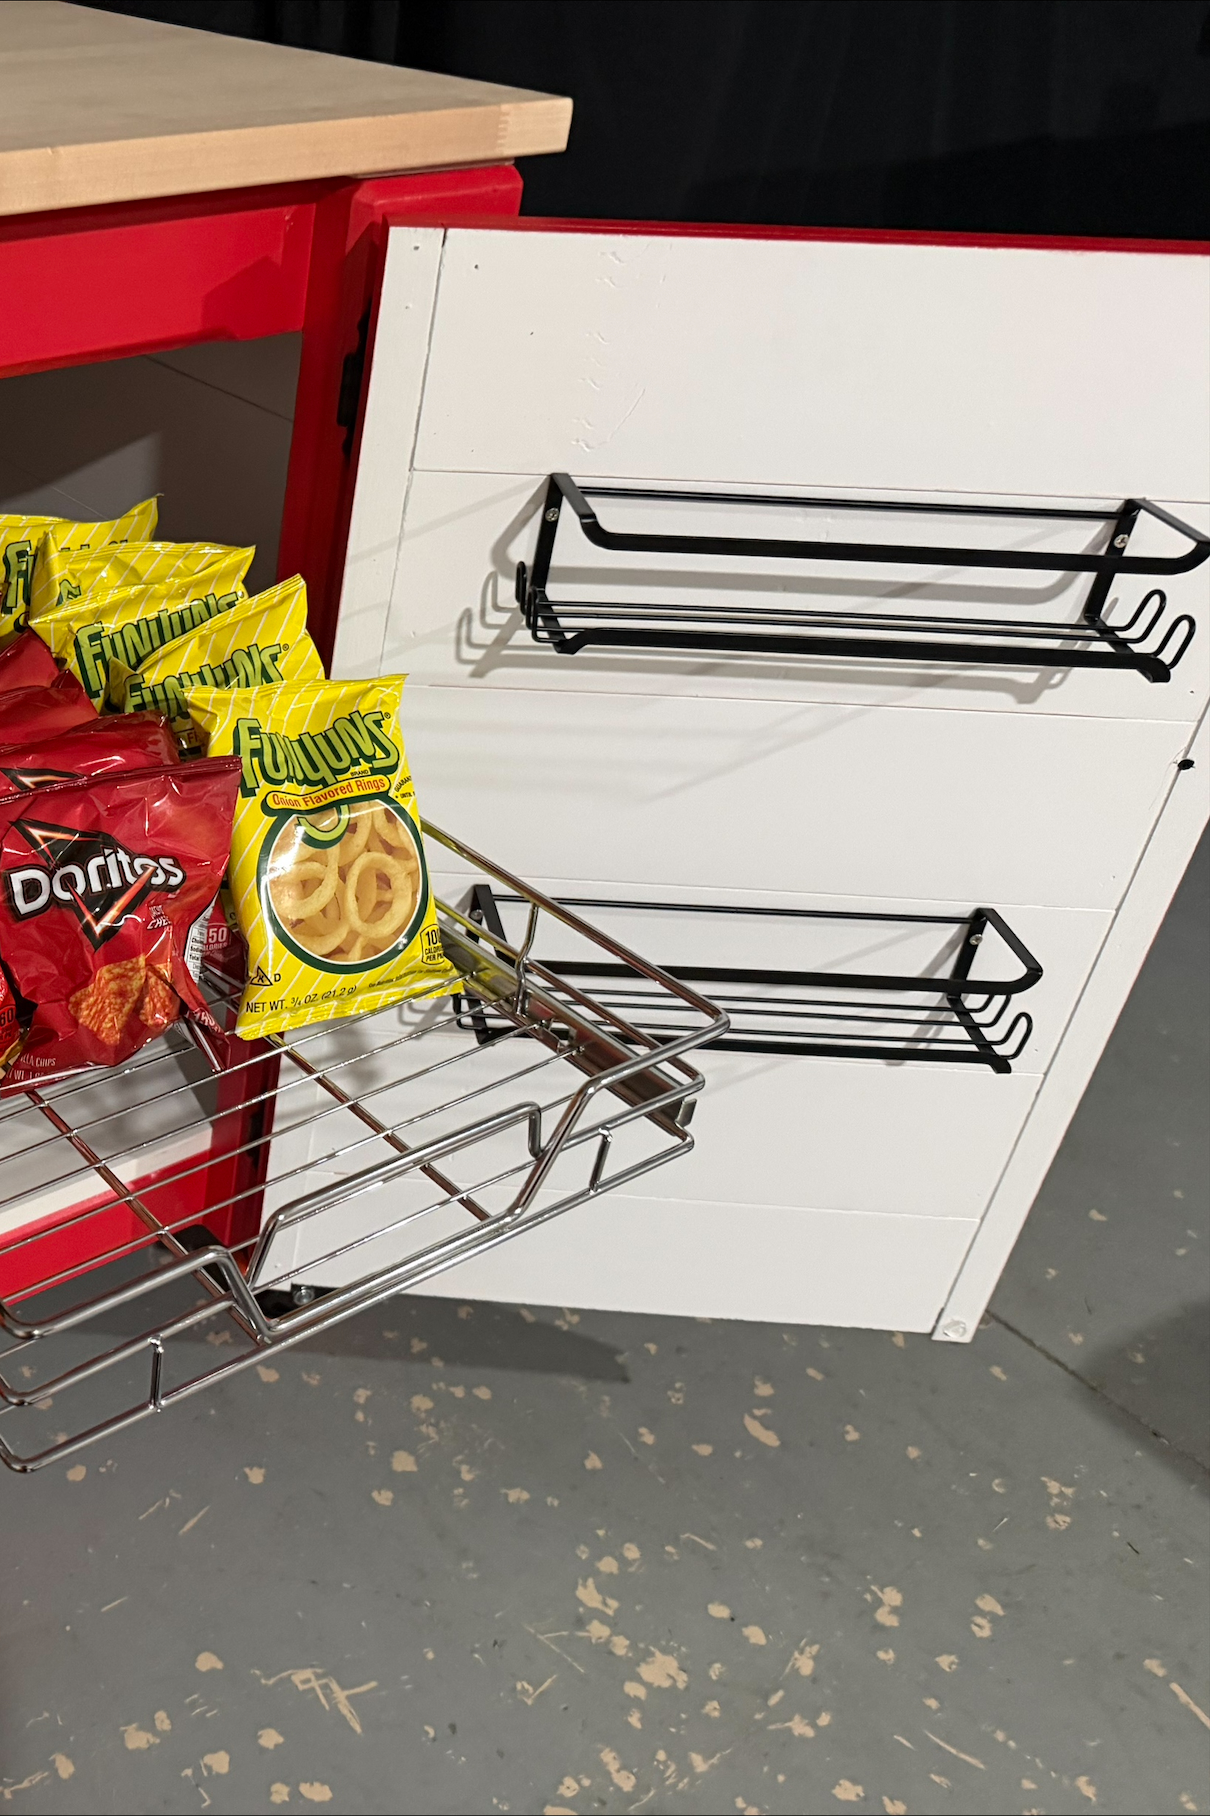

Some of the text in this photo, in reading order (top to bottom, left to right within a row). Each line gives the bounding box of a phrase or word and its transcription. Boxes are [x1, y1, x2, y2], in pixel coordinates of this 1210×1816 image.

[233, 710, 399, 798] FUNYUNS
[350, 769, 369, 777] BRAND
[272, 777, 386, 808] Onion Flavored Rings
[8, 846, 185, 916] Doritos
[245, 1001, 267, 1013] NET
[269, 999, 288, 1012] WT.
